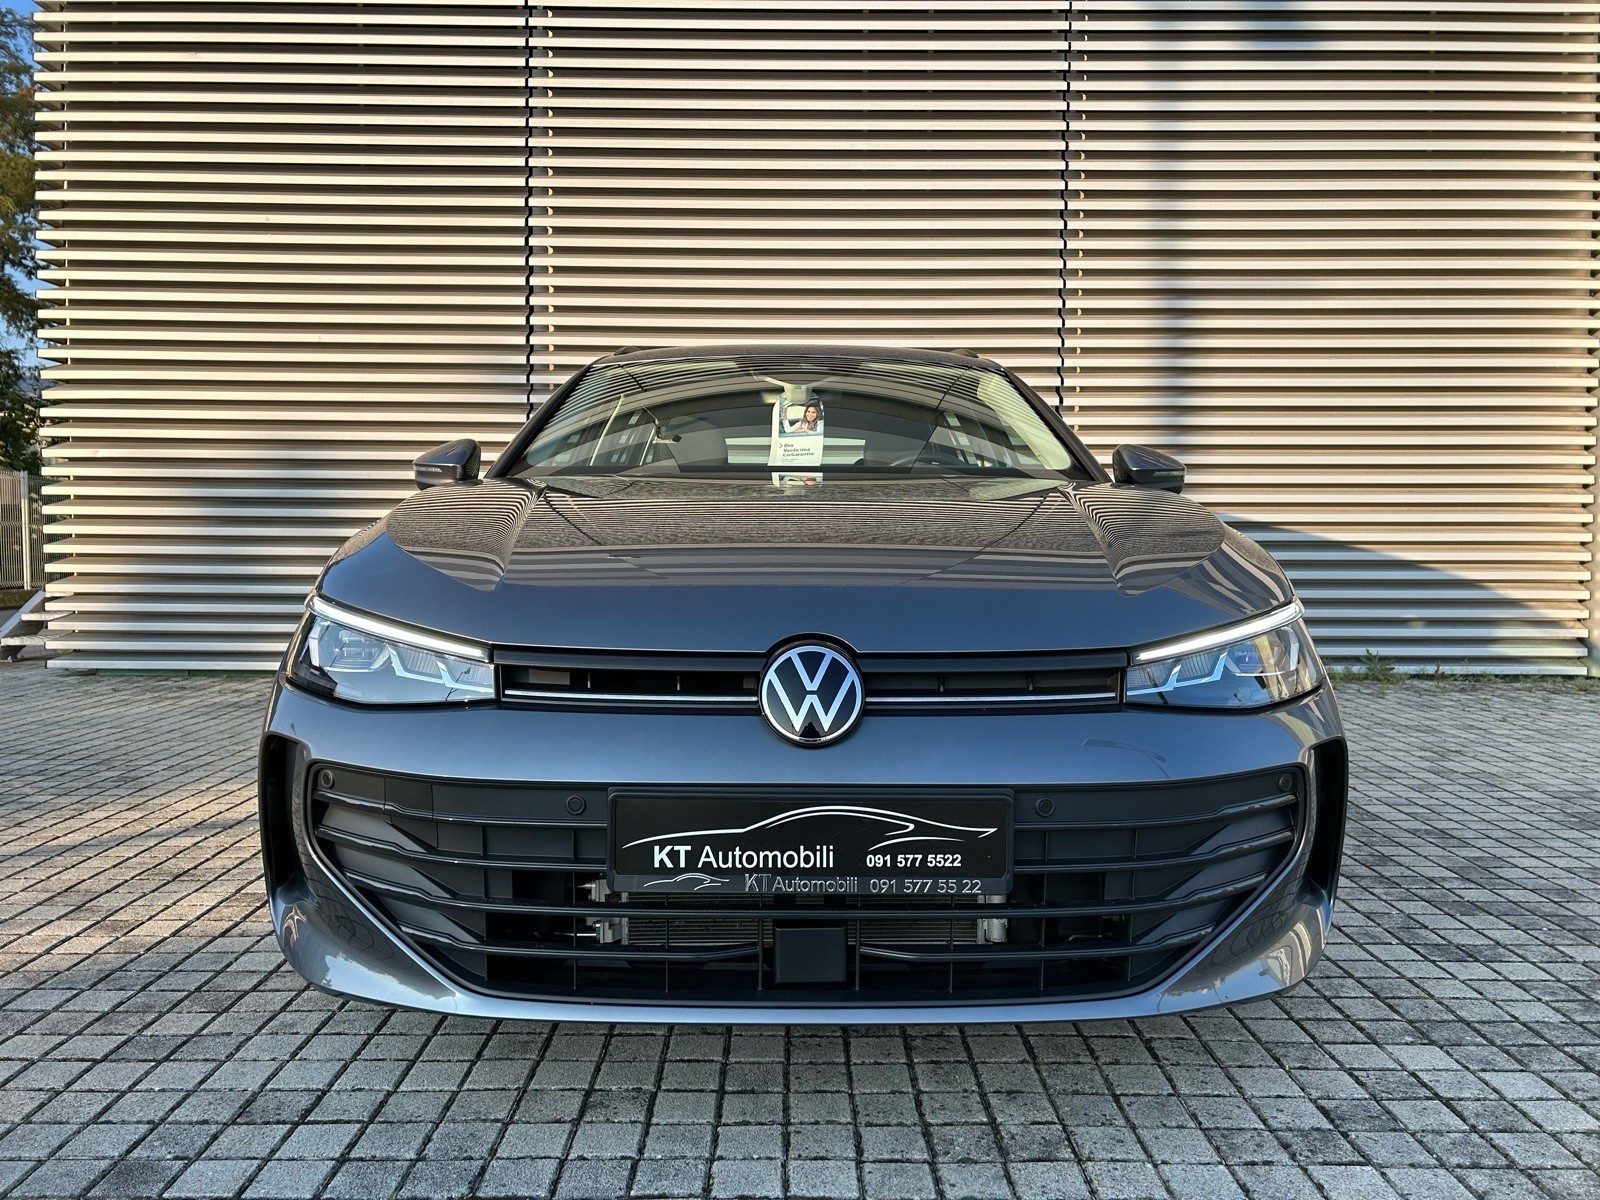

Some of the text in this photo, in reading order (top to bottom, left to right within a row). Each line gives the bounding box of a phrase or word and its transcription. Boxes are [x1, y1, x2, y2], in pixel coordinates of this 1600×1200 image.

[653, 845, 833, 868] KT Automobili
[866, 854, 961, 867] 091 577 5522
[745, 874, 857, 892] KT Automobili
[870, 879, 982, 893] 091 577 55 22
